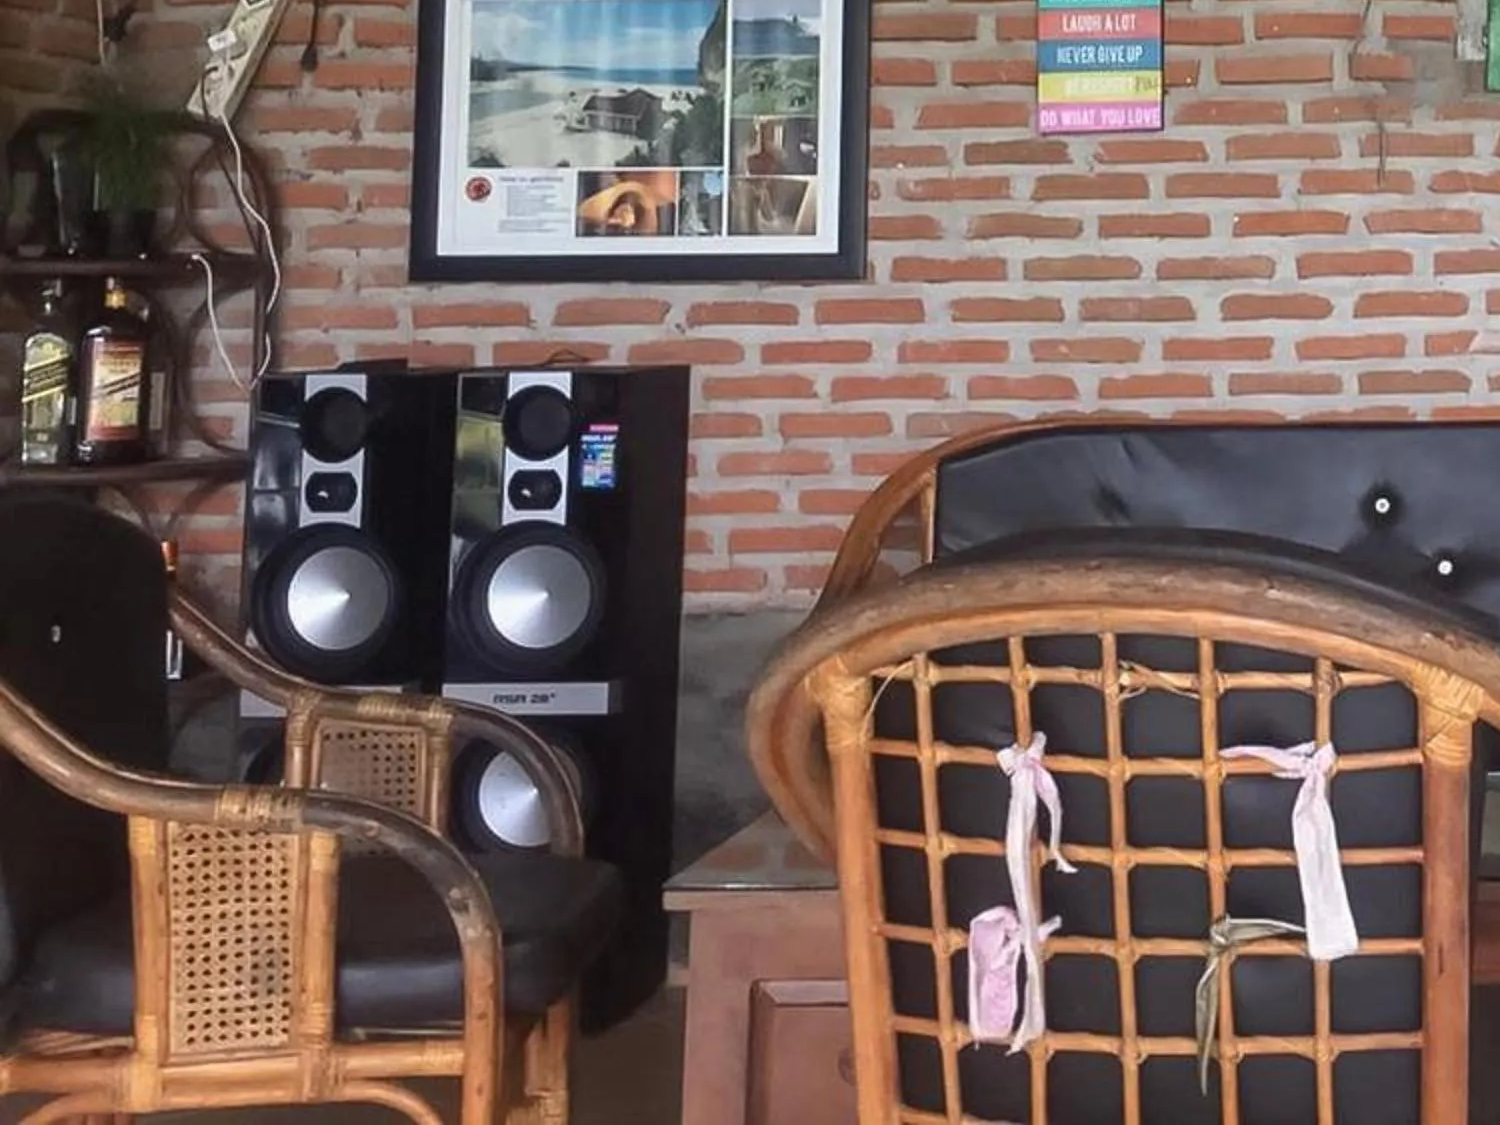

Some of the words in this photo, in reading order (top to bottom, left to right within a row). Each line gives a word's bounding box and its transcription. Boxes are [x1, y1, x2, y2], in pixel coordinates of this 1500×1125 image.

[1061, 13, 1102, 33] LAUGH
[1115, 13, 1137, 31] LOT
[1056, 47, 1096, 65] NEVER
[1096, 46, 1126, 64] GIVE
[1127, 45, 1144, 63] UP
[1060, 109, 1096, 127] WHAT
[1100, 108, 1127, 126] YOU
